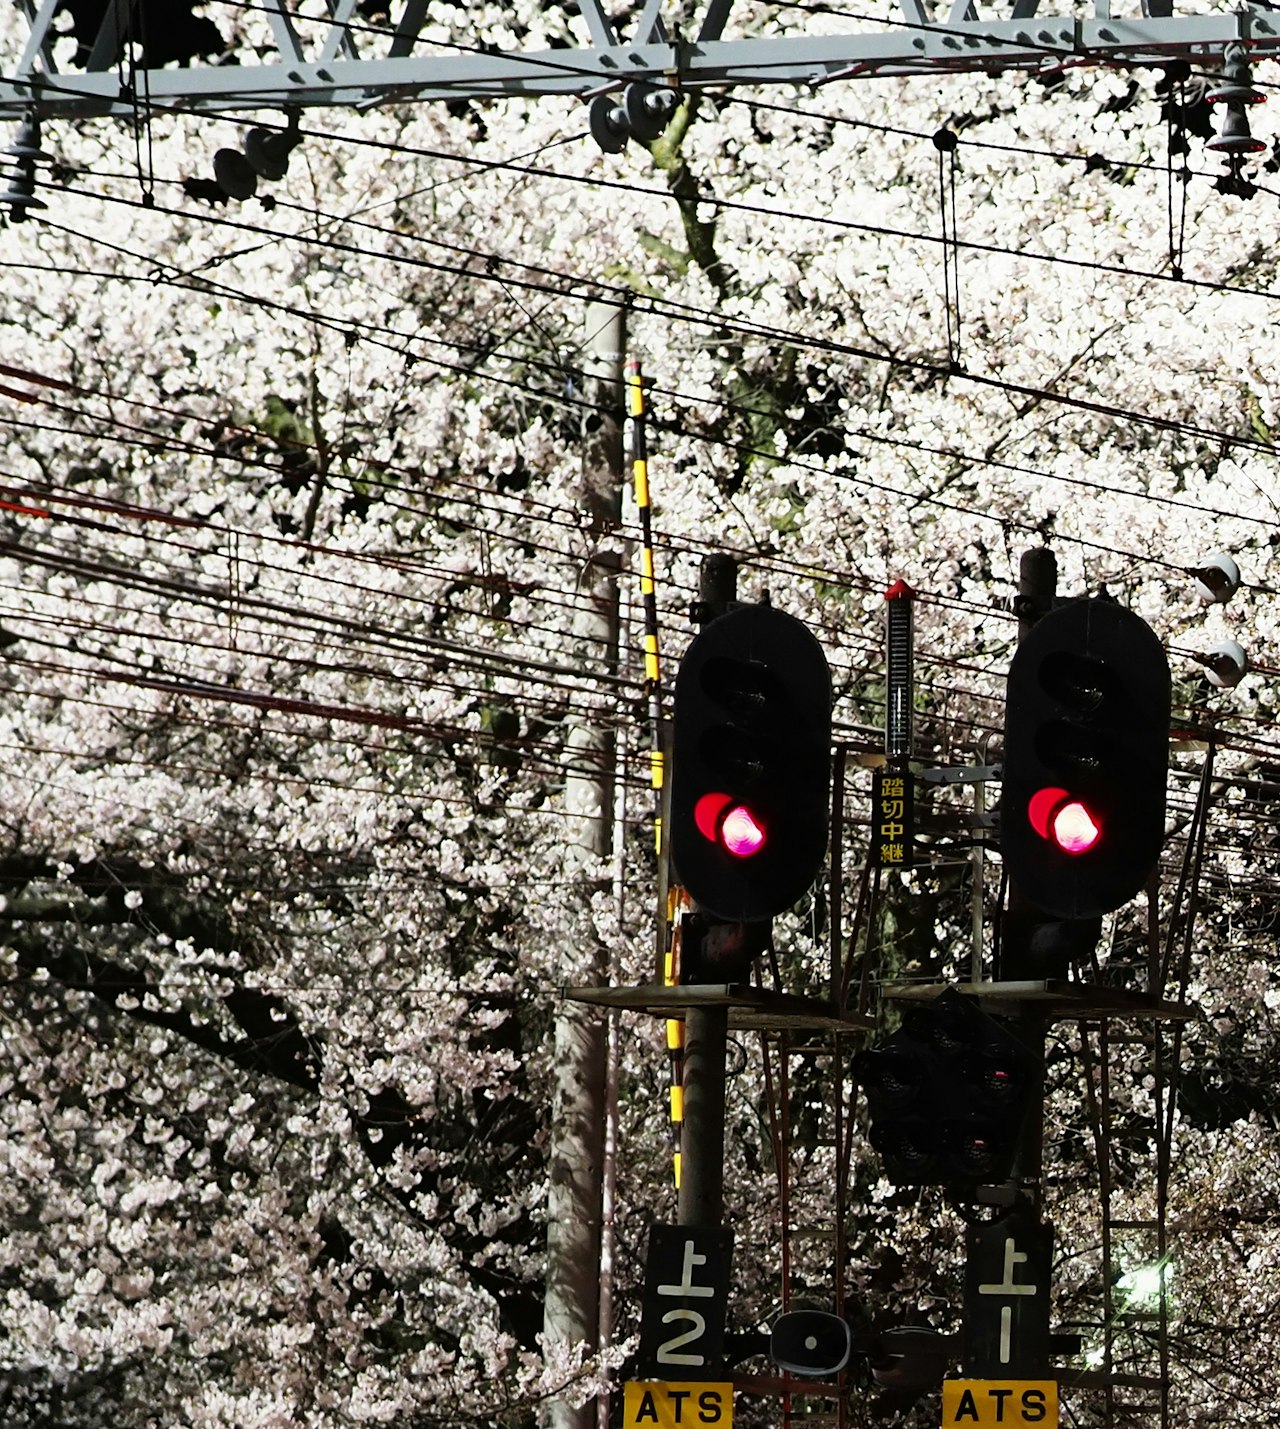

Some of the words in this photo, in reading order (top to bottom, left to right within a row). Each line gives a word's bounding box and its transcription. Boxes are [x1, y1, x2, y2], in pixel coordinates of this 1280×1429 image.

[880, 777, 904, 863] 踏切中継
[635, 1390, 722, 1423] ATS
[954, 1389, 1046, 1422] ATS
